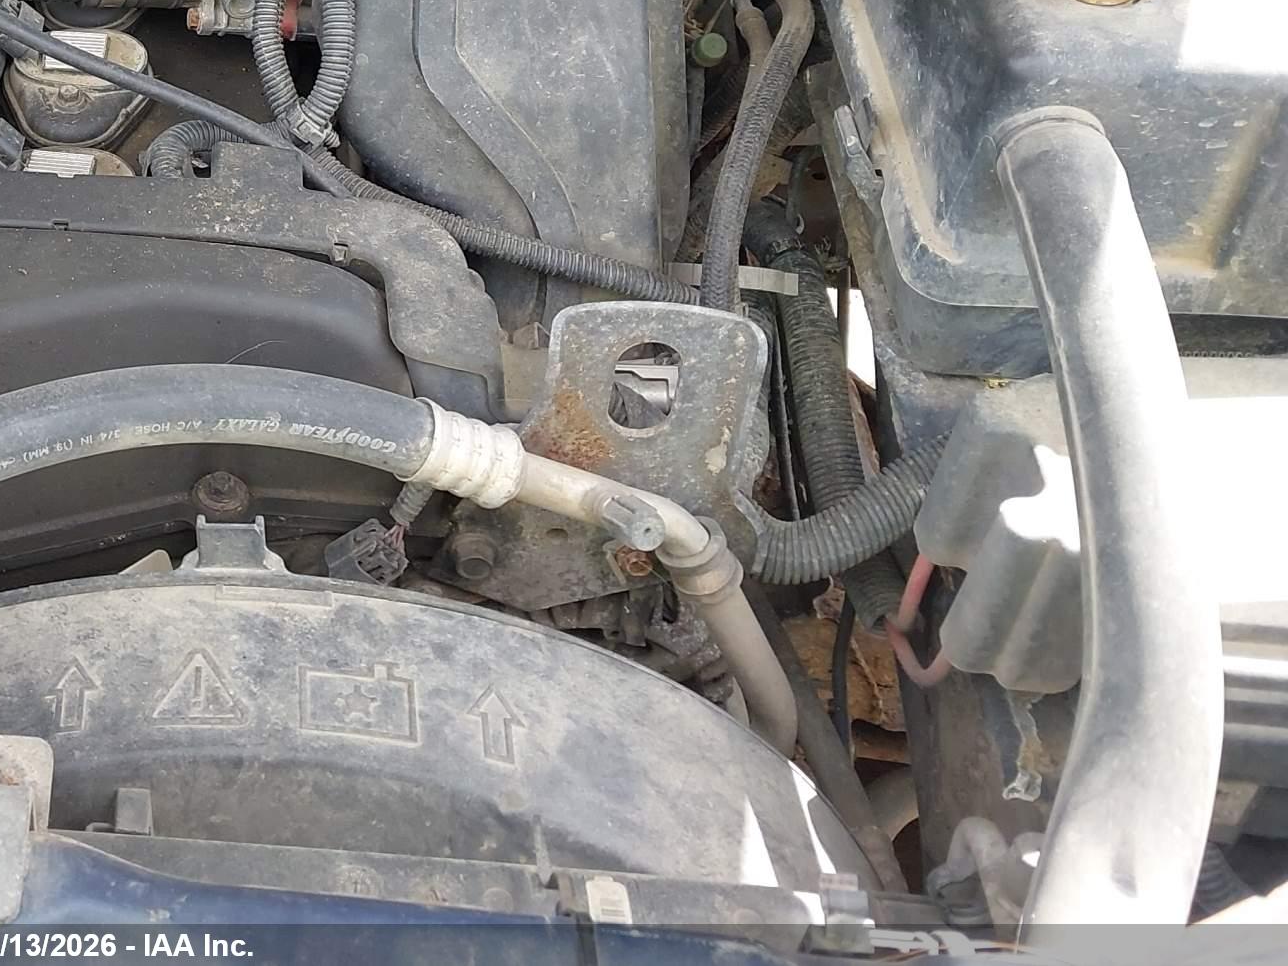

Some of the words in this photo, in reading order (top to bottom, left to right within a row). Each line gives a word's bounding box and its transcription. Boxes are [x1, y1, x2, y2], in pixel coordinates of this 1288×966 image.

[134, 421, 171, 436] HOSE
[176, 420, 203, 431] A/C
[212, 417, 281, 433] GALAXY
[79, 435, 94, 447] IN
[99, 428, 121, 441] 3/4
[291, 422, 397, 453] GOODYEAR
[22, 444, 50, 463] MM)
